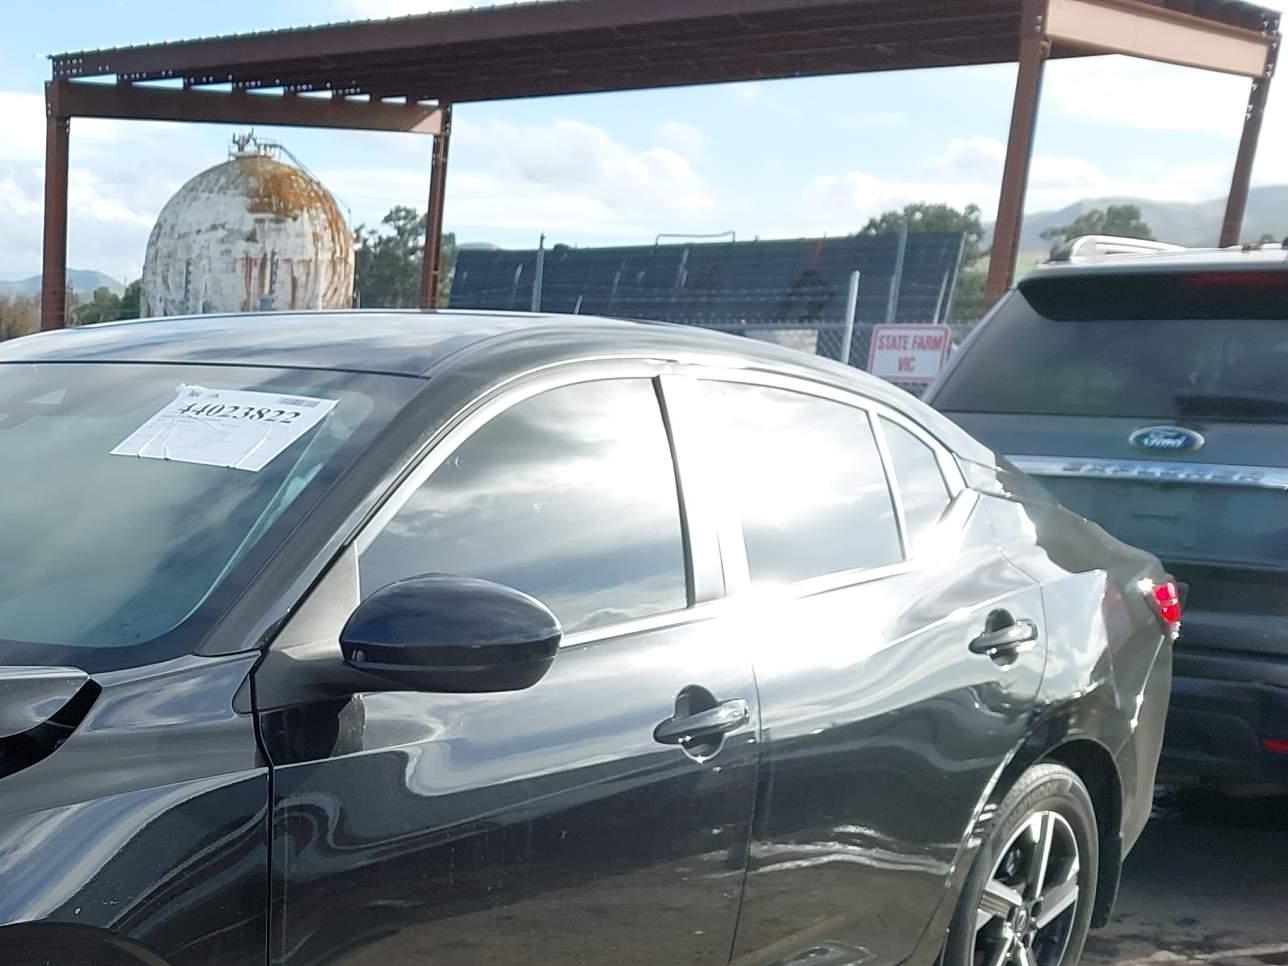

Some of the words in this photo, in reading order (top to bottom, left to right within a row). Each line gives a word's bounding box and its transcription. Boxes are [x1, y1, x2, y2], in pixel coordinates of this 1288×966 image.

[877, 334, 910, 351] STATE
[913, 335, 944, 352] FARM
[898, 356, 916, 372] VIC
[178, 402, 301, 424] 44023822
[1143, 431, 1187, 448] Ford
